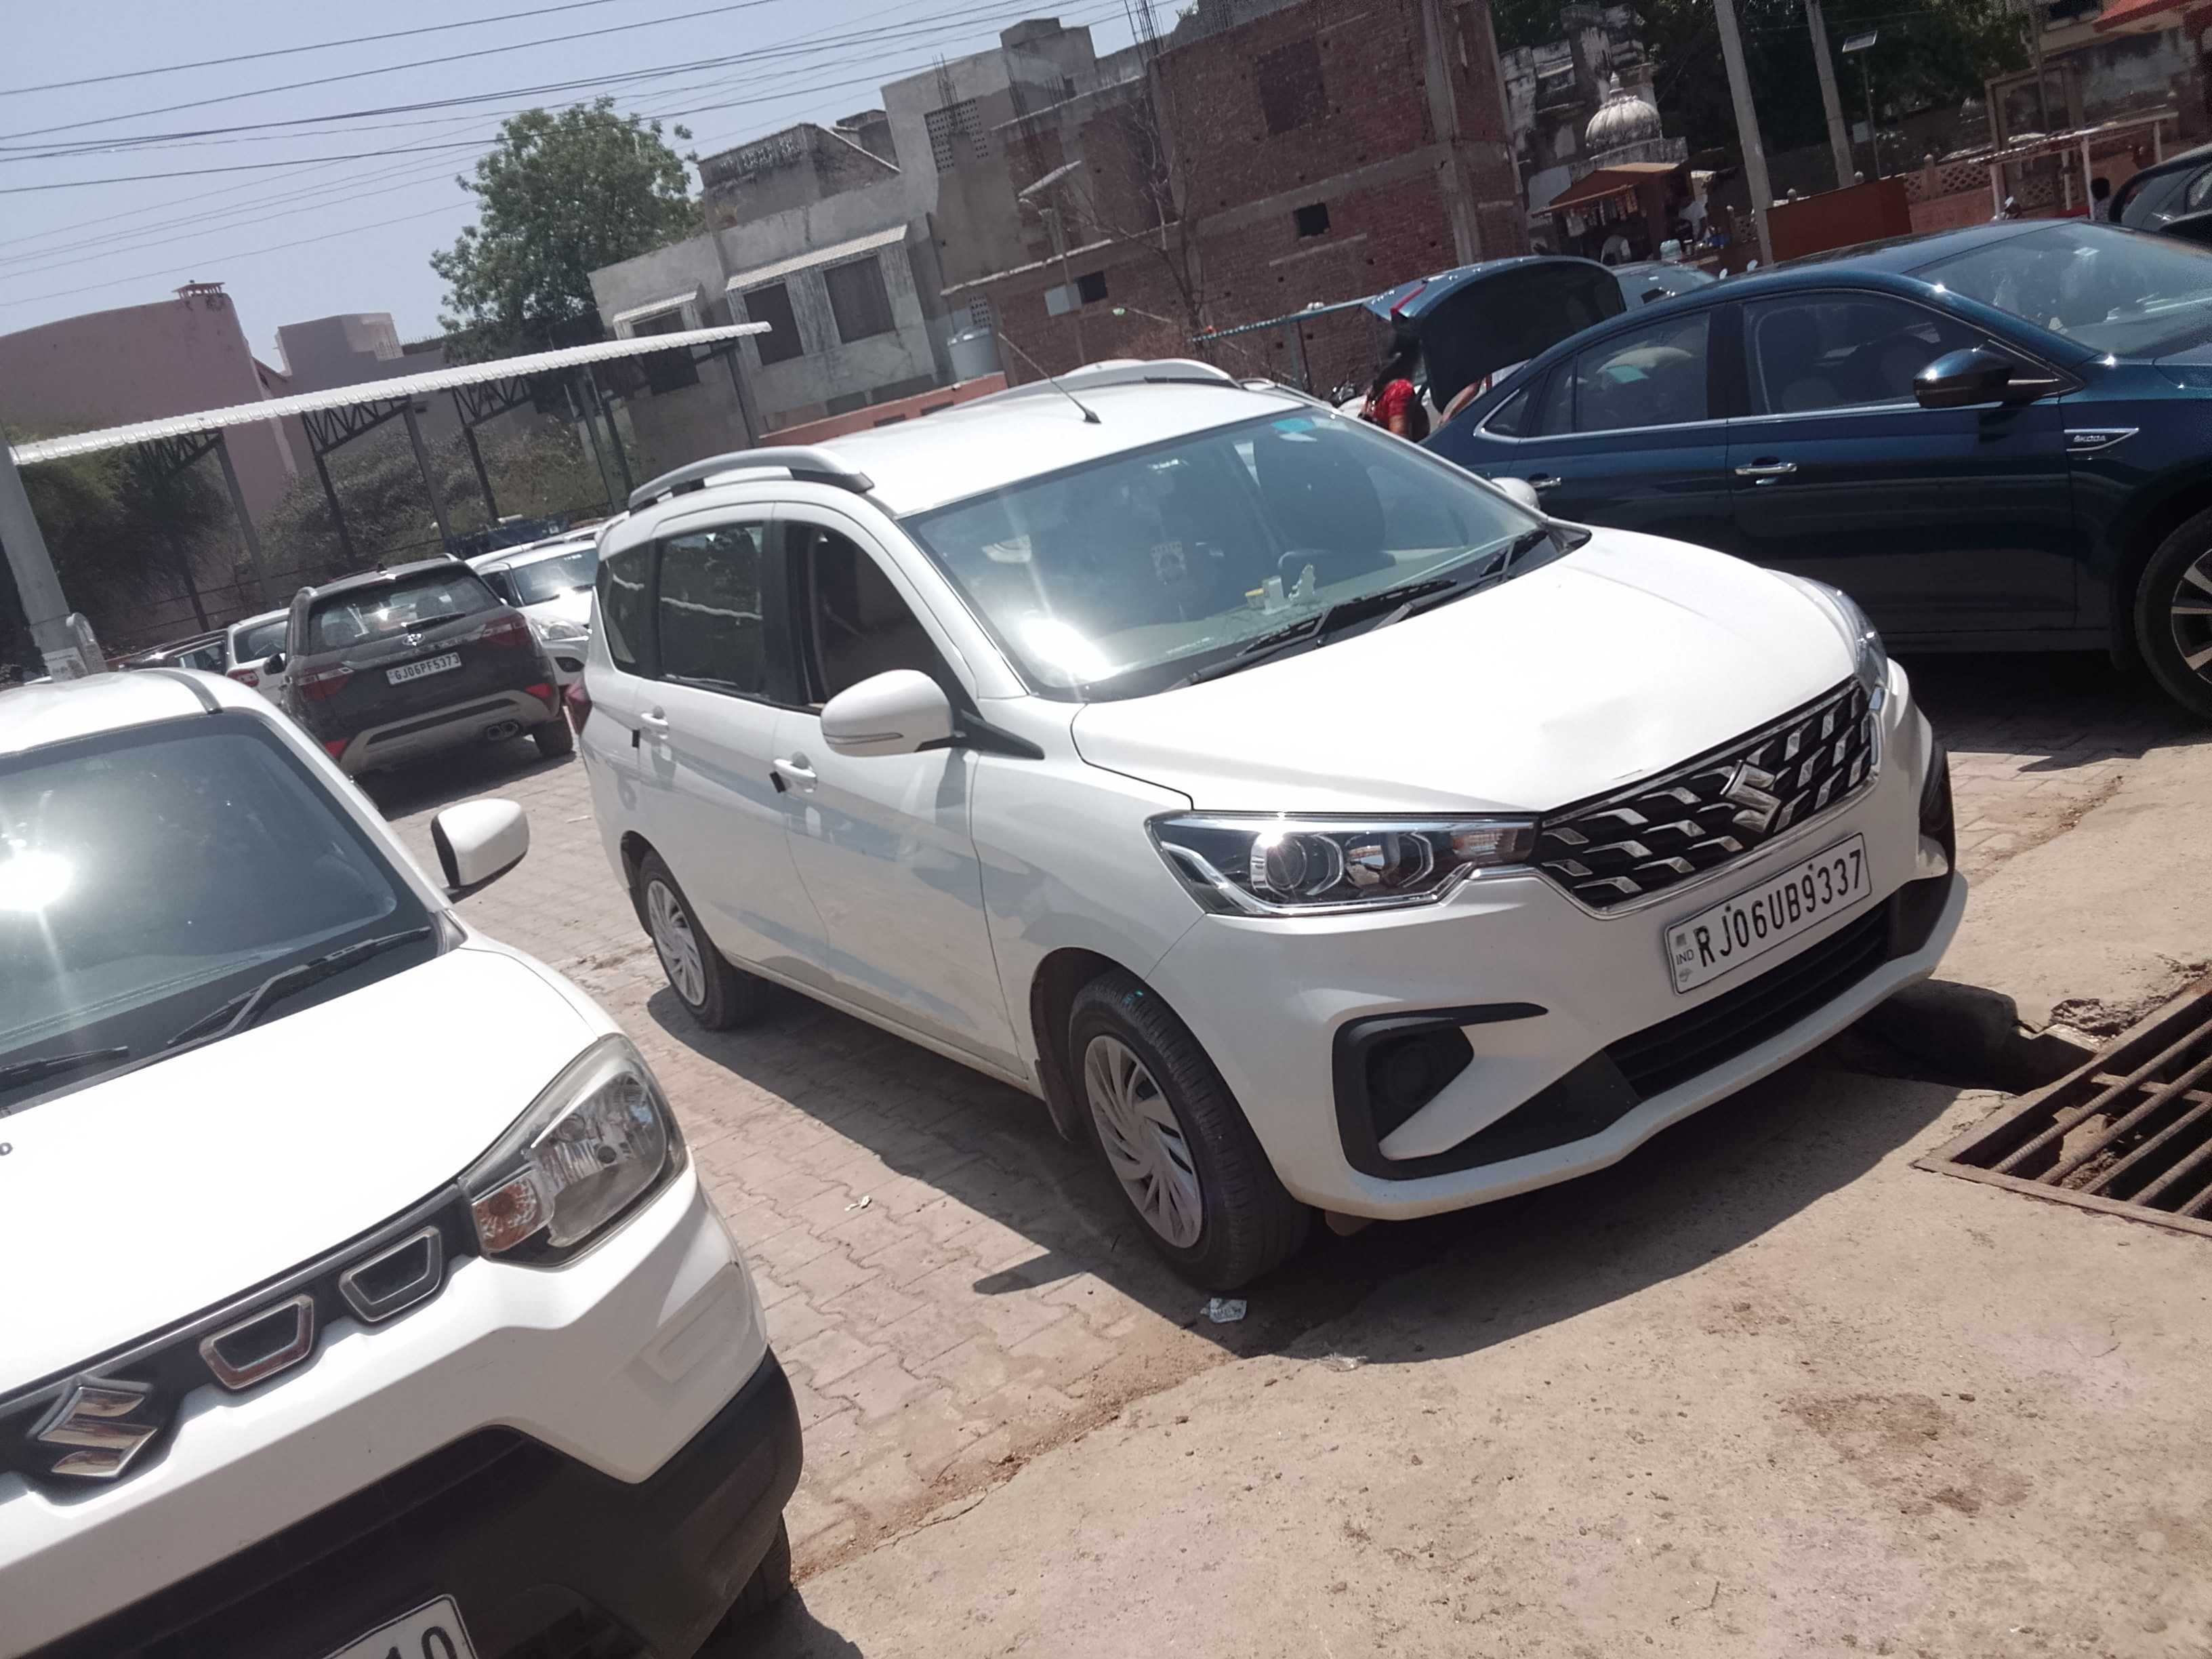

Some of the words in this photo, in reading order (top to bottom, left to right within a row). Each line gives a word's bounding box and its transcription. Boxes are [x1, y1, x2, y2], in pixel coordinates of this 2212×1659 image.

[395, 654, 460, 680] GJ06PF5373
[1693, 848, 1861, 968] RJ06UB9337
[1675, 949, 1694, 966] IND
